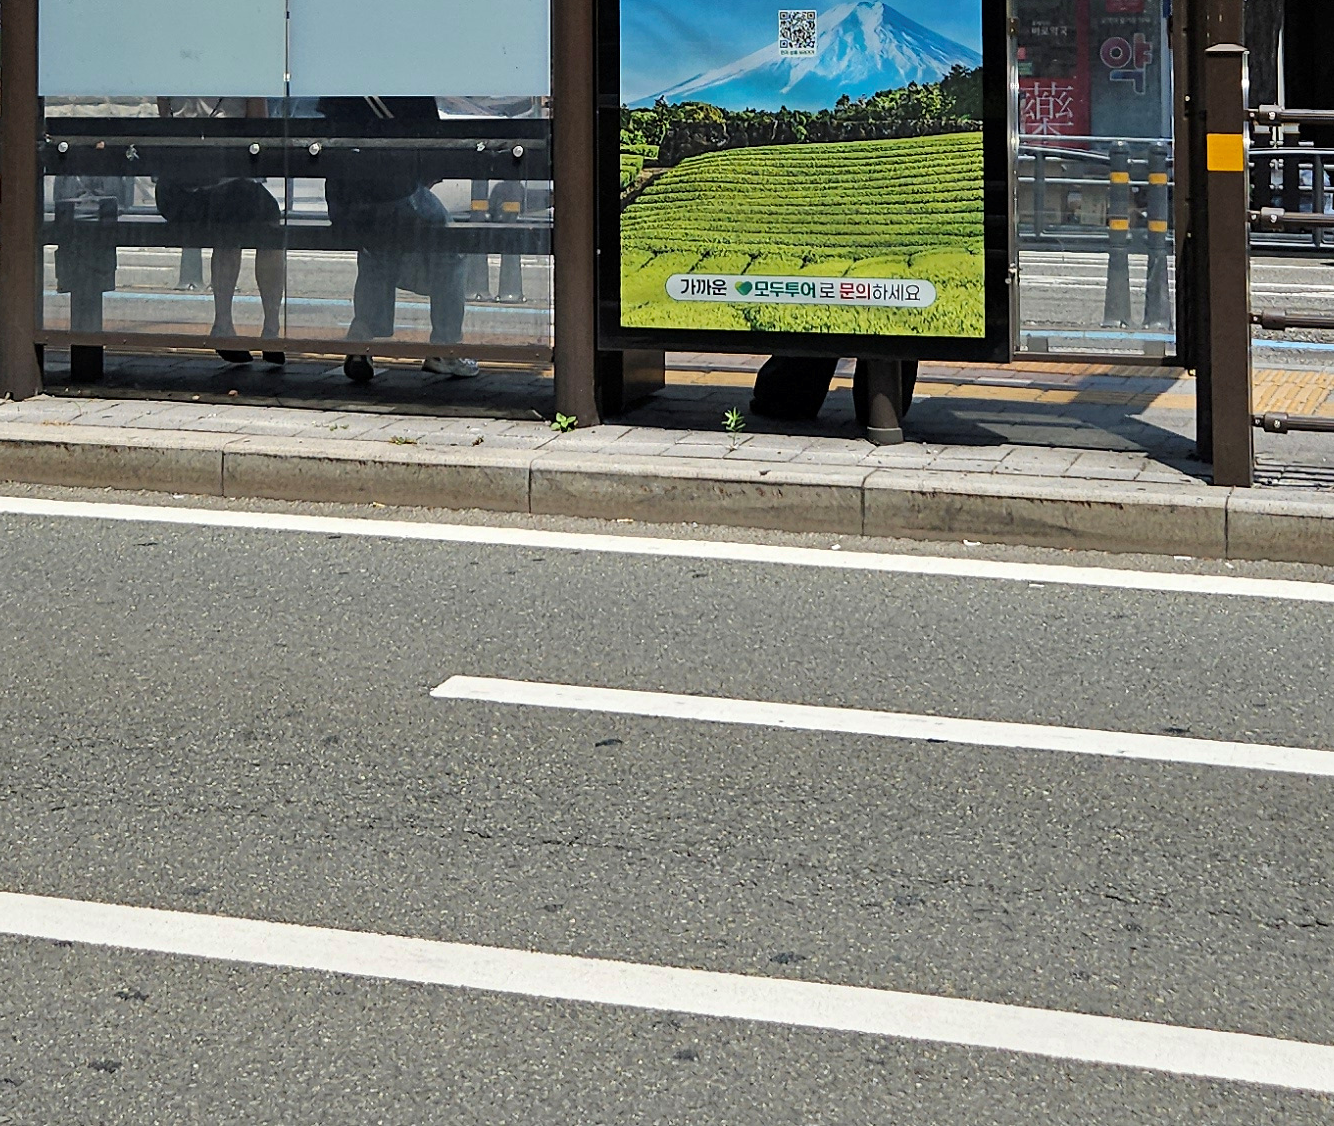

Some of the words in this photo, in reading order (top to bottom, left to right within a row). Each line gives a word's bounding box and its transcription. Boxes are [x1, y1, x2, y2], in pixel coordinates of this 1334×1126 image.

[1099, 32, 1154, 96] 약
[680, 279, 727, 297] 가까운
[754, 281, 816, 298] 모두투어
[839, 282, 921, 302] 문의하세요
